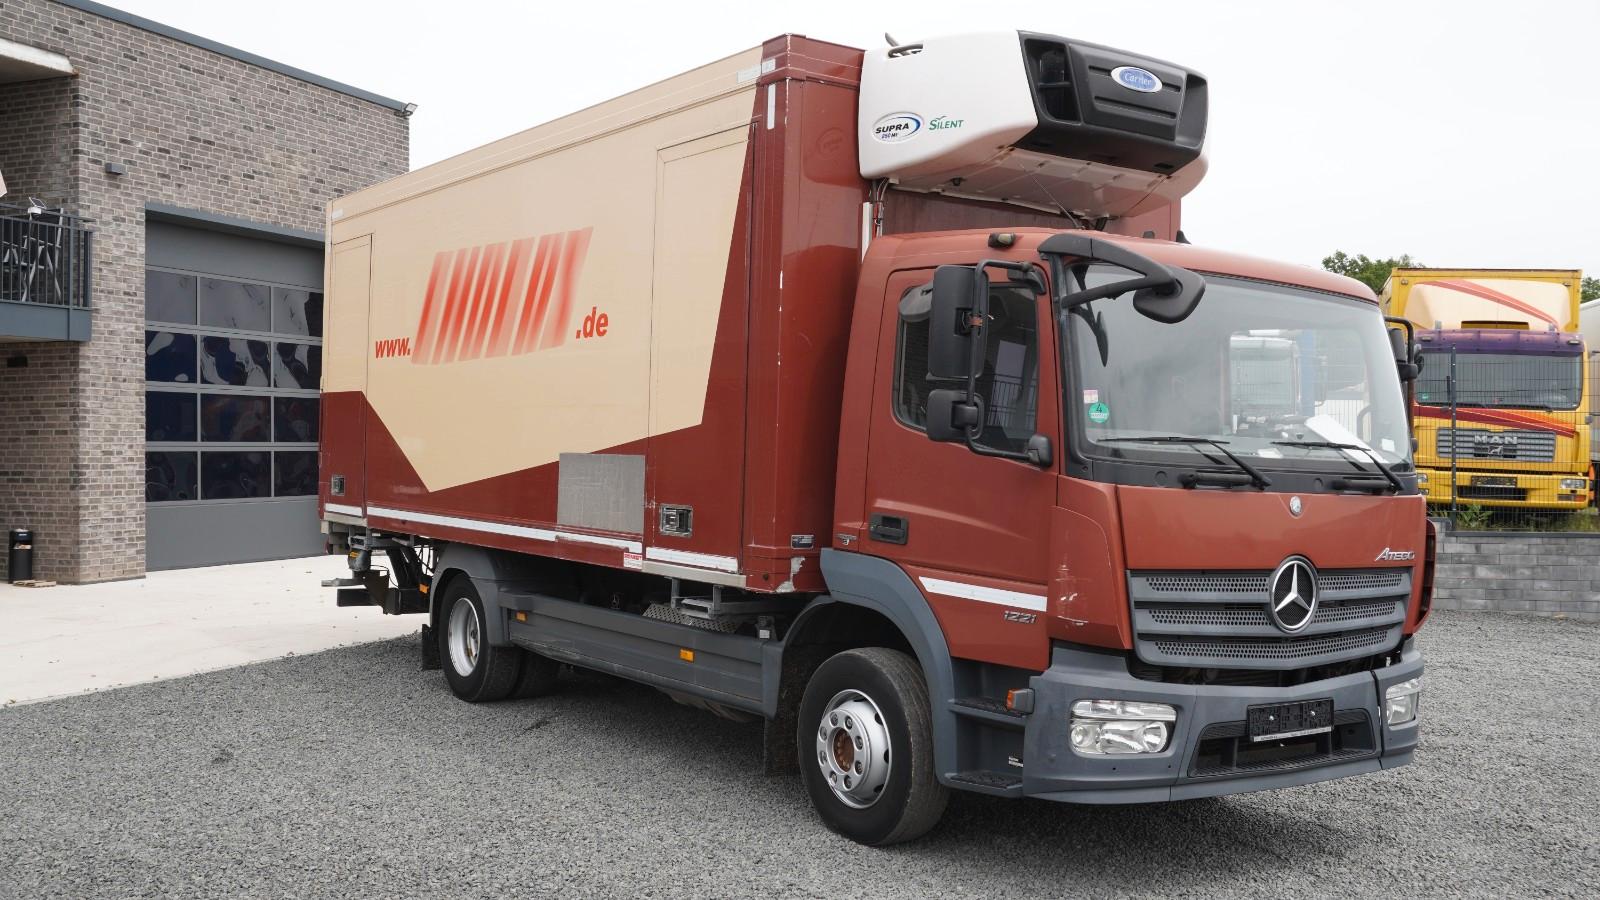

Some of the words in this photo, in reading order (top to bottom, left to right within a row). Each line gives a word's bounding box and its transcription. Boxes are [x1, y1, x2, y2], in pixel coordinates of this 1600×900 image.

[875, 122, 909, 134] SUPRA
[375, 337, 411, 359] www.
[575, 306, 609, 339] .de
[1096, 403, 1103, 413] 4
[1474, 435, 1518, 445] MAN
[1004, 610, 1037, 624] 1221
